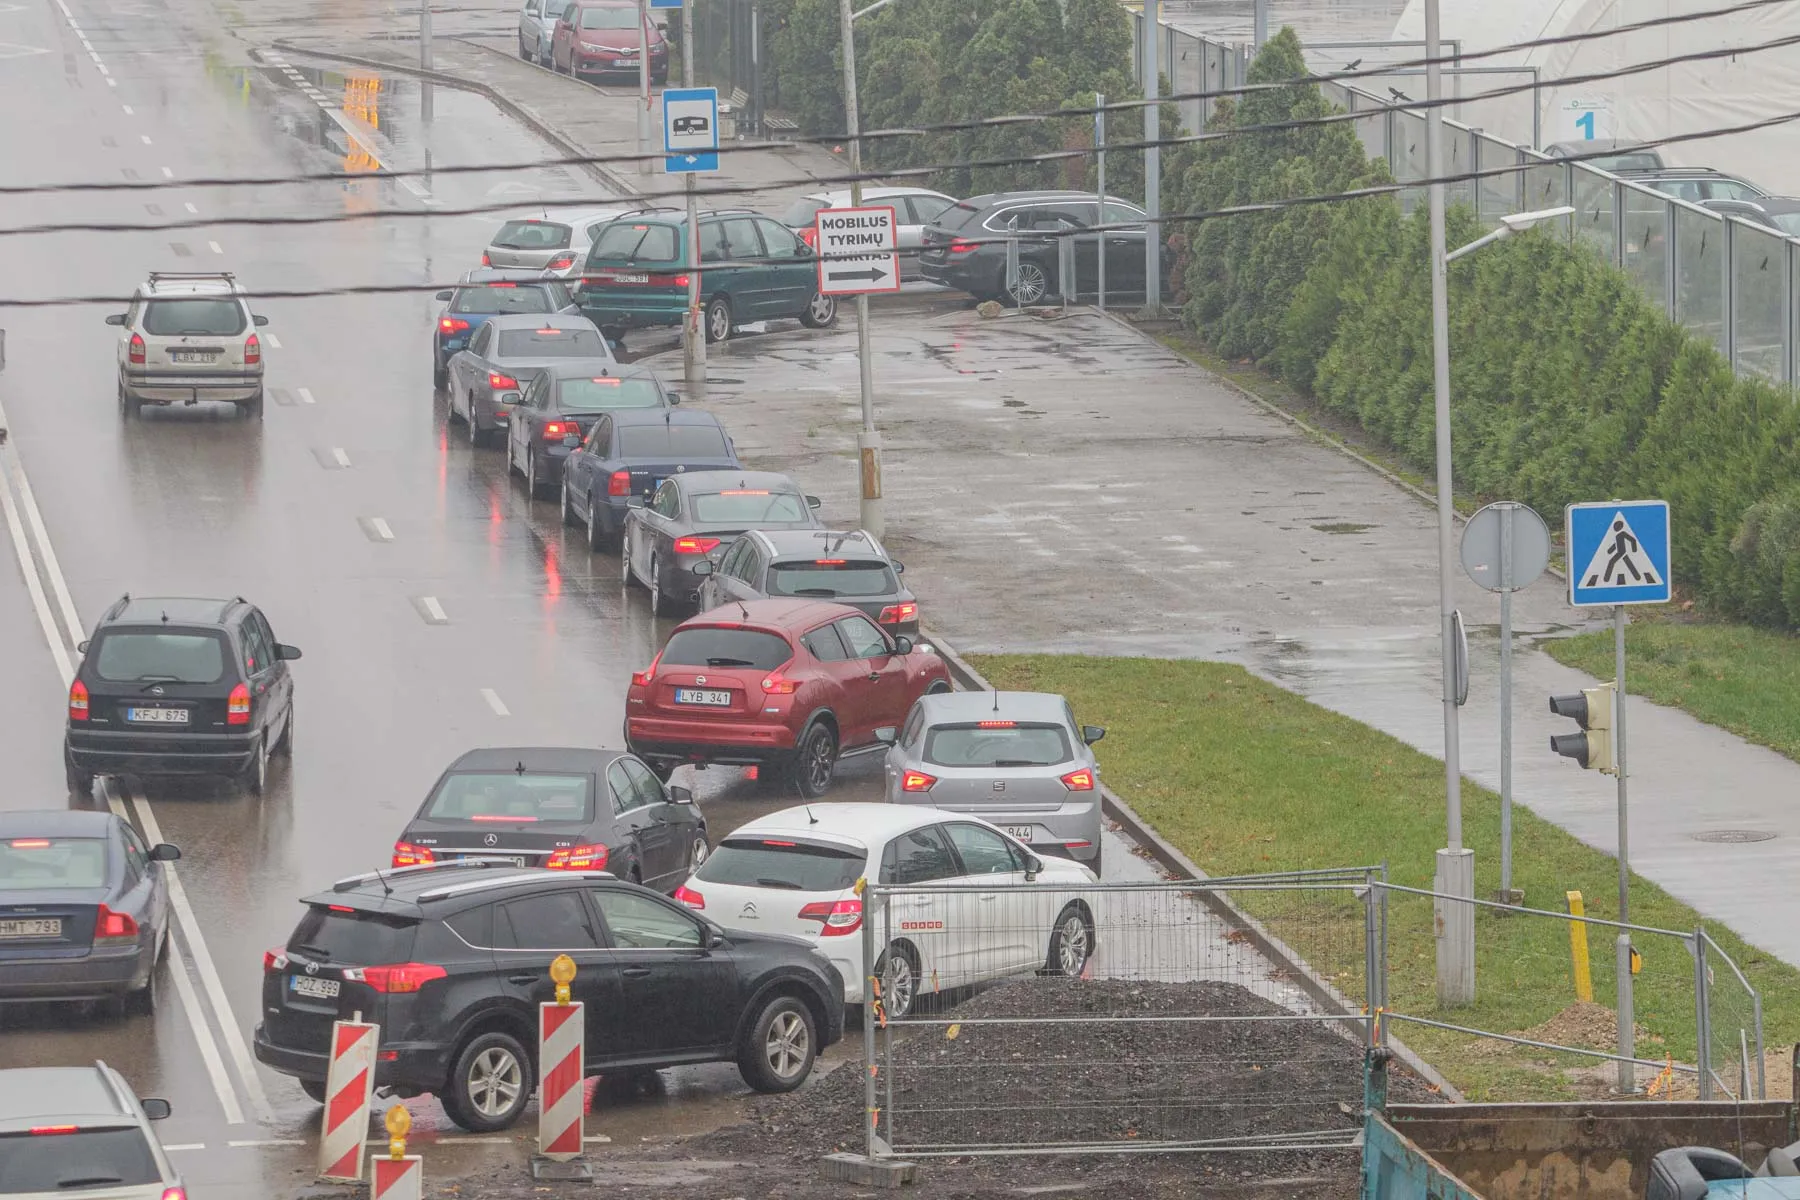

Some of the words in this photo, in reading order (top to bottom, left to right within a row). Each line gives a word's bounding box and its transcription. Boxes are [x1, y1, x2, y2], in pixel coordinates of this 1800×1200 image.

[1576, 112, 1594, 140] 1
[822, 216, 888, 230] MOBILUS
[828, 233, 883, 247] TYRIMŲ
[681, 692, 703, 702] LYB
[710, 693, 728, 703] 341
[134, 710, 159, 720] KFJ
[166, 711, 186, 721] 675
[1008, 827, 1030, 837] 844
[0, 921, 27, 933] HMT
[36, 920, 58, 932] 793
[321, 981, 338, 994] 999
